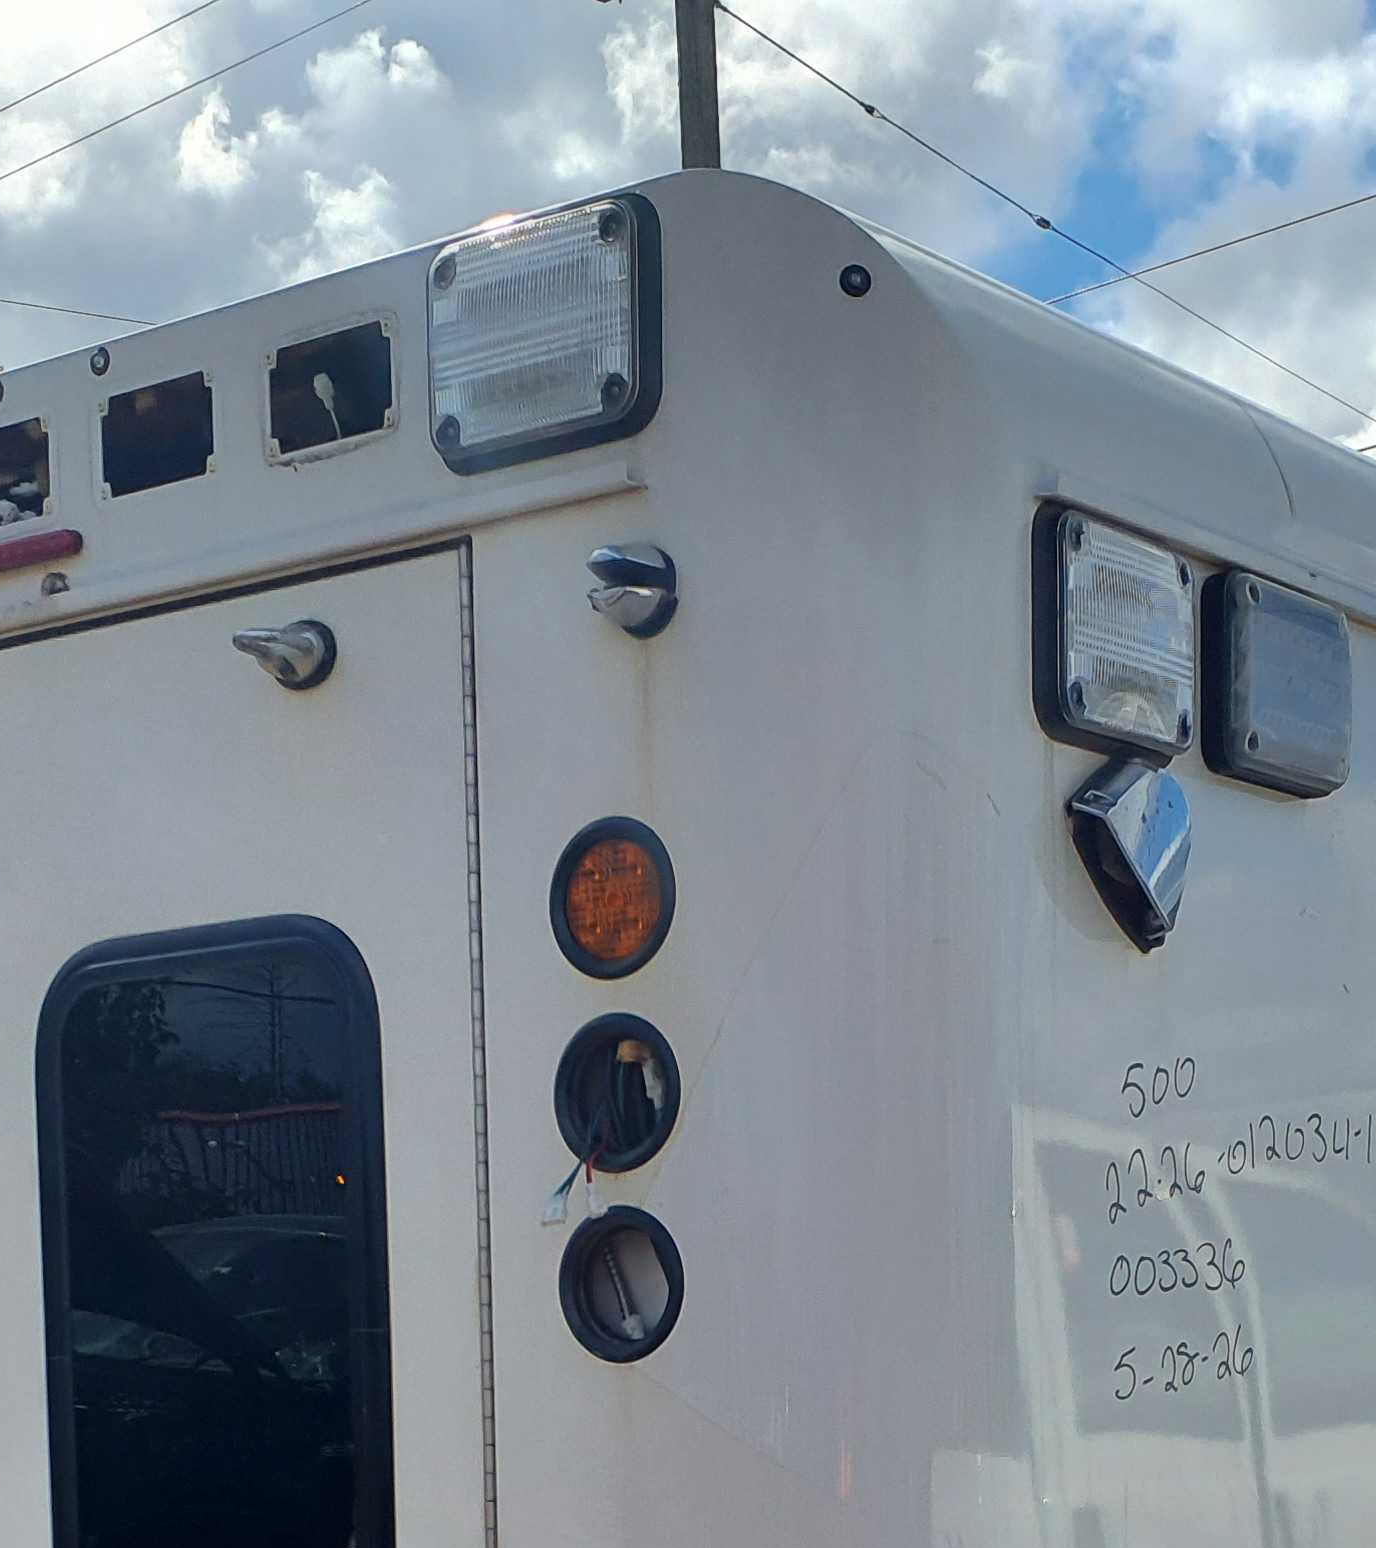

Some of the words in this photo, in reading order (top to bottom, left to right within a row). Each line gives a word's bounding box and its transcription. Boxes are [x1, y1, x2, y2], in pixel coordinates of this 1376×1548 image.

[1121, 1056, 1195, 1118] 500
[1109, 1238, 1245, 1296] 003336
[1113, 1324, 1254, 1400] 5-28-26
